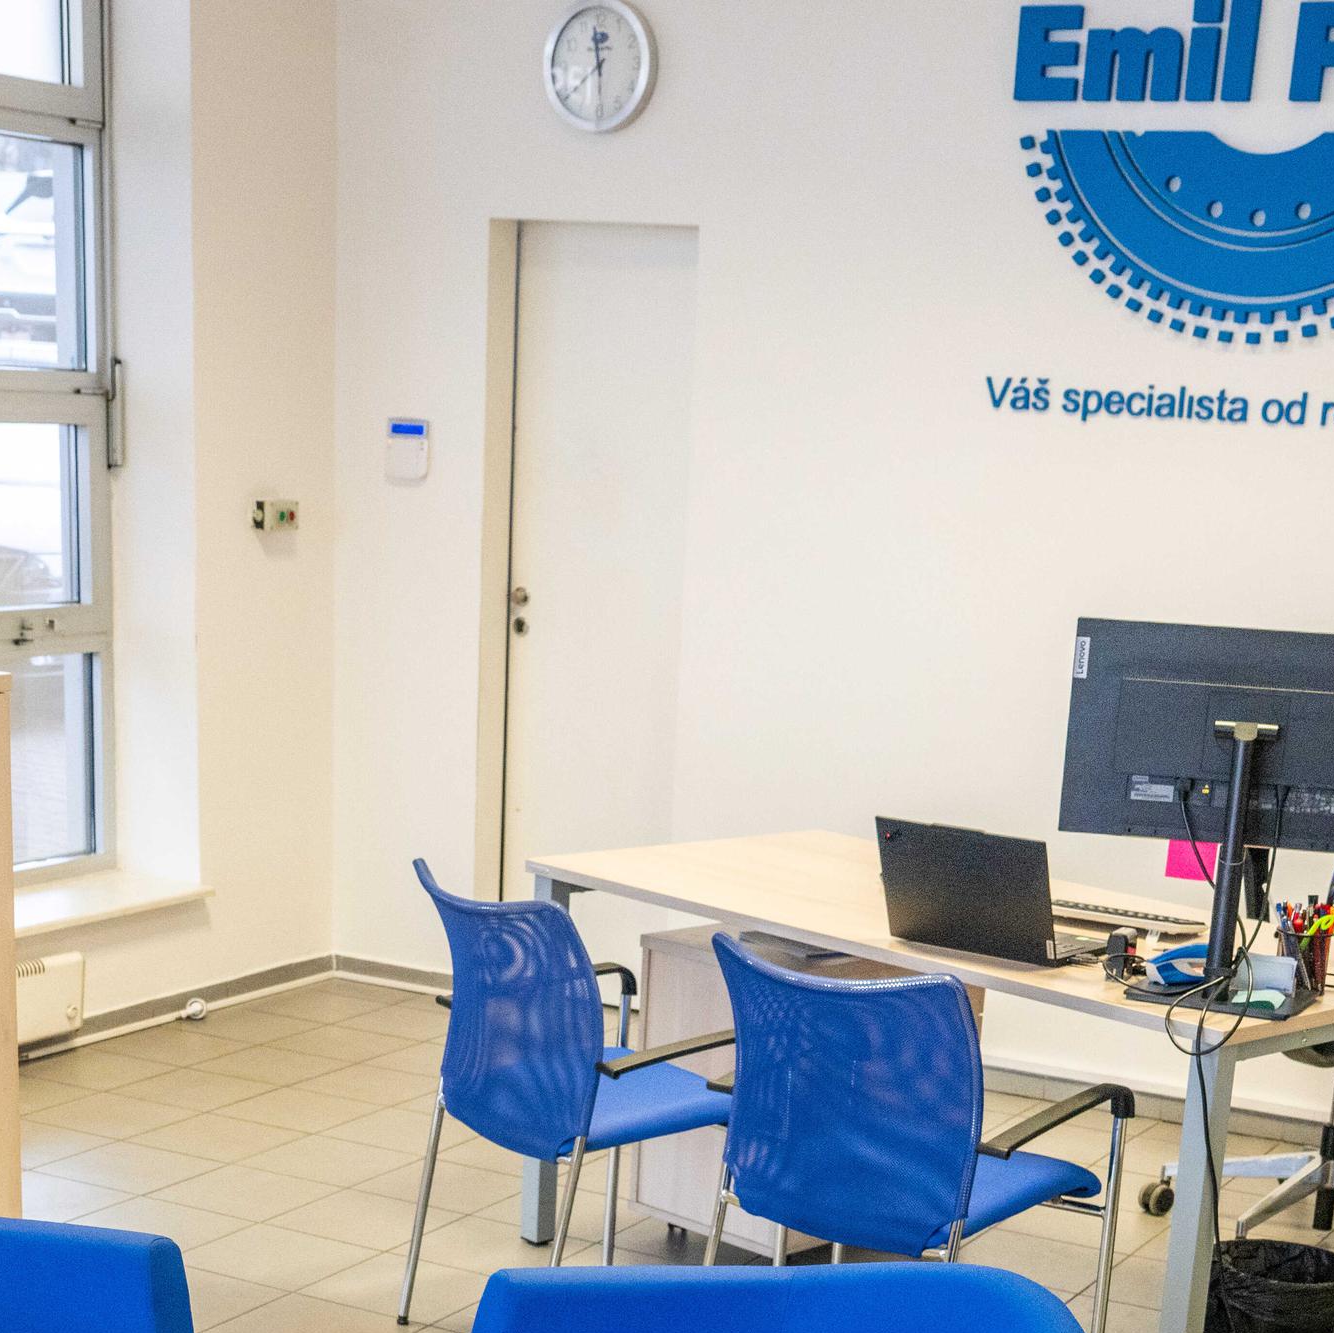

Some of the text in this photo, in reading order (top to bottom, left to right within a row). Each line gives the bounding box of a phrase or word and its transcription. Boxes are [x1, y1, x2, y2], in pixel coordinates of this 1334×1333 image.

[1014, 0, 1263, 101] Emil
[985, 377, 1050, 410] Váš
[1261, 392, 1310, 425] od
[1077, 640, 1087, 675] Lenovo
